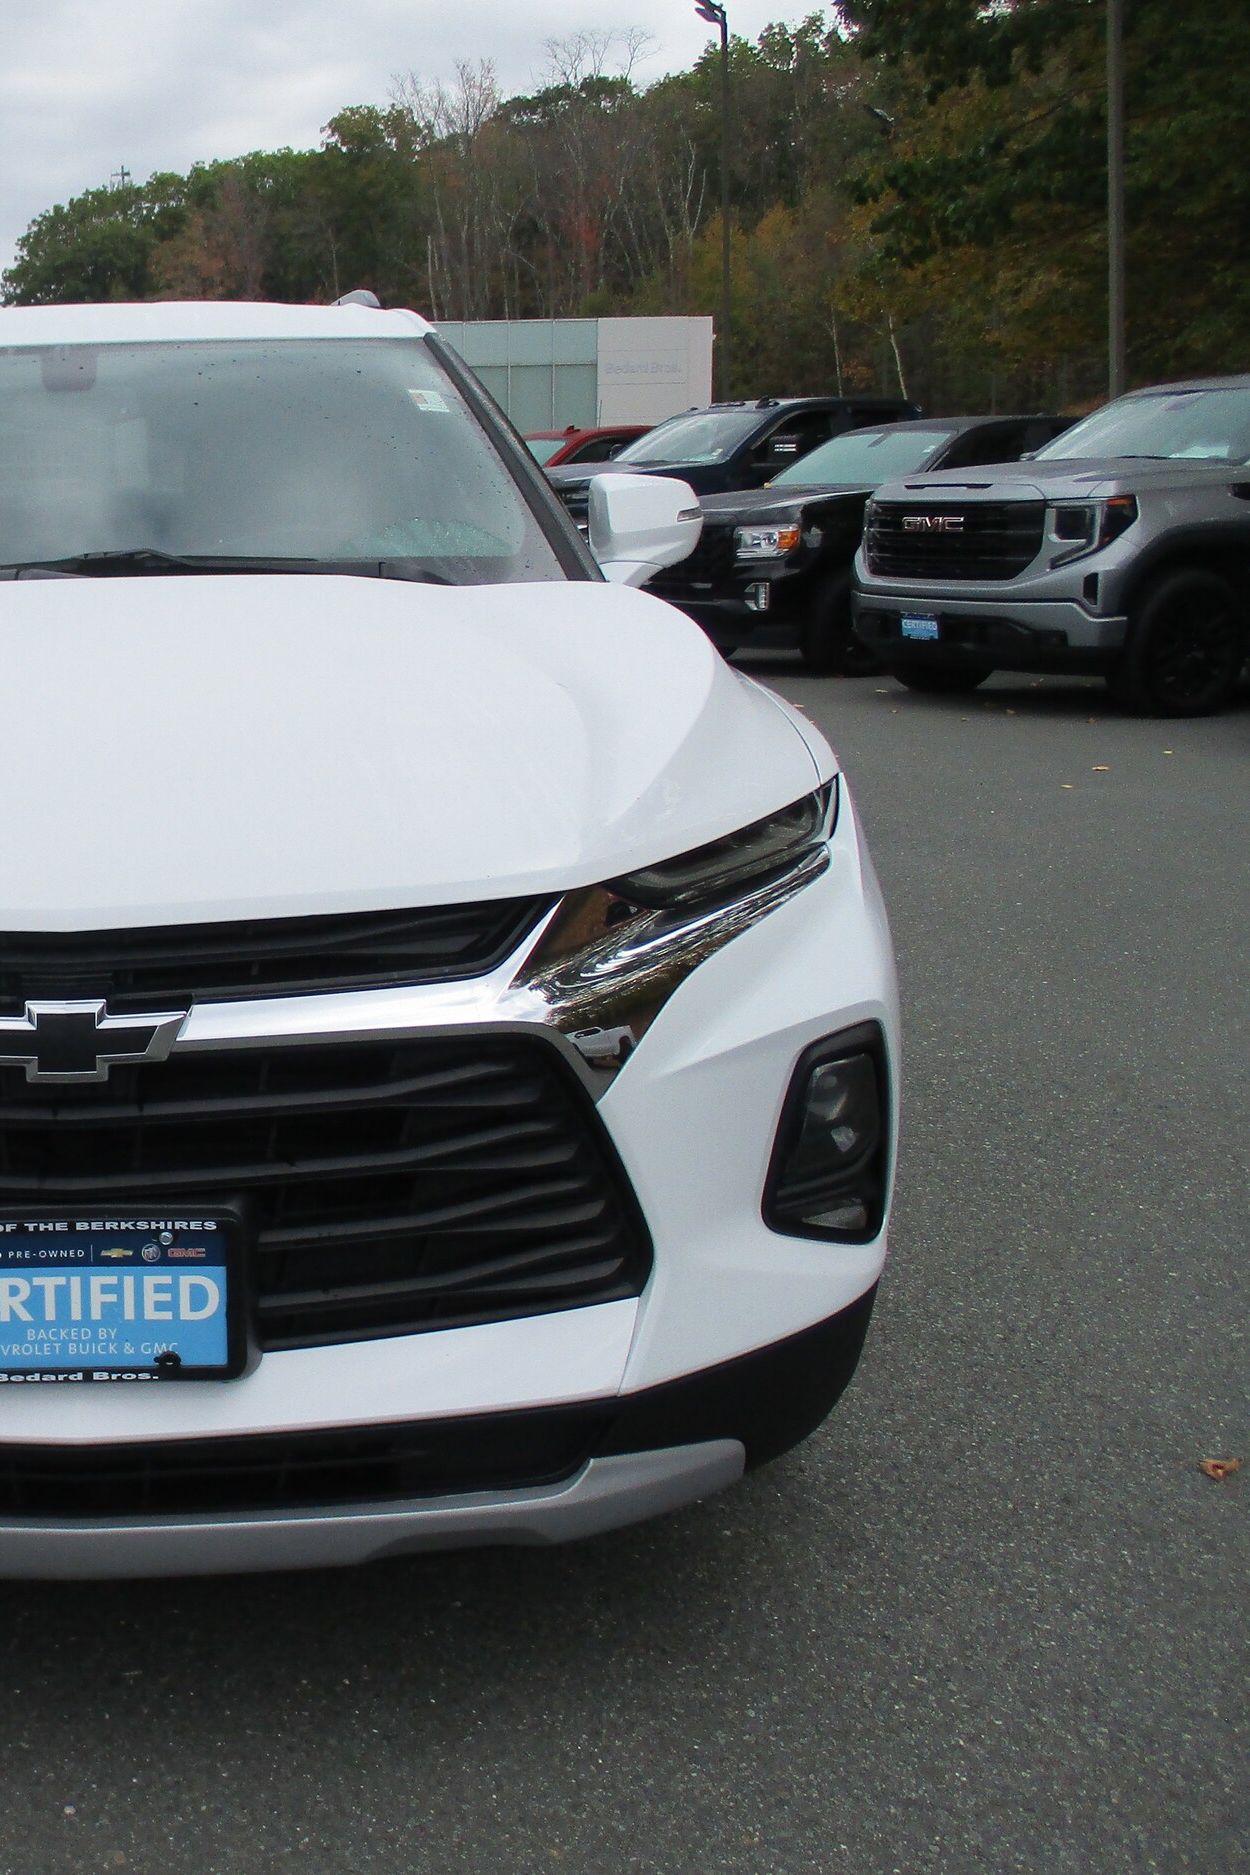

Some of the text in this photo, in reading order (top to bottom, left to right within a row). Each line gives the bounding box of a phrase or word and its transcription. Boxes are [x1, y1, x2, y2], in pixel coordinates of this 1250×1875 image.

[902, 516, 964, 532] GMC
[24, 1222, 68, 1232] THE
[75, 1220, 217, 1231] BERKSHIRES
[8, 1249, 85, 1259] PRE-OWNED
[167, 1247, 207, 1258] GMC
[26, 1327, 118, 1341] BACKED BY
[68, 1342, 118, 1355] BUICK
[123, 1342, 136, 1355] &
[92, 1370, 159, 1382] Bros.
